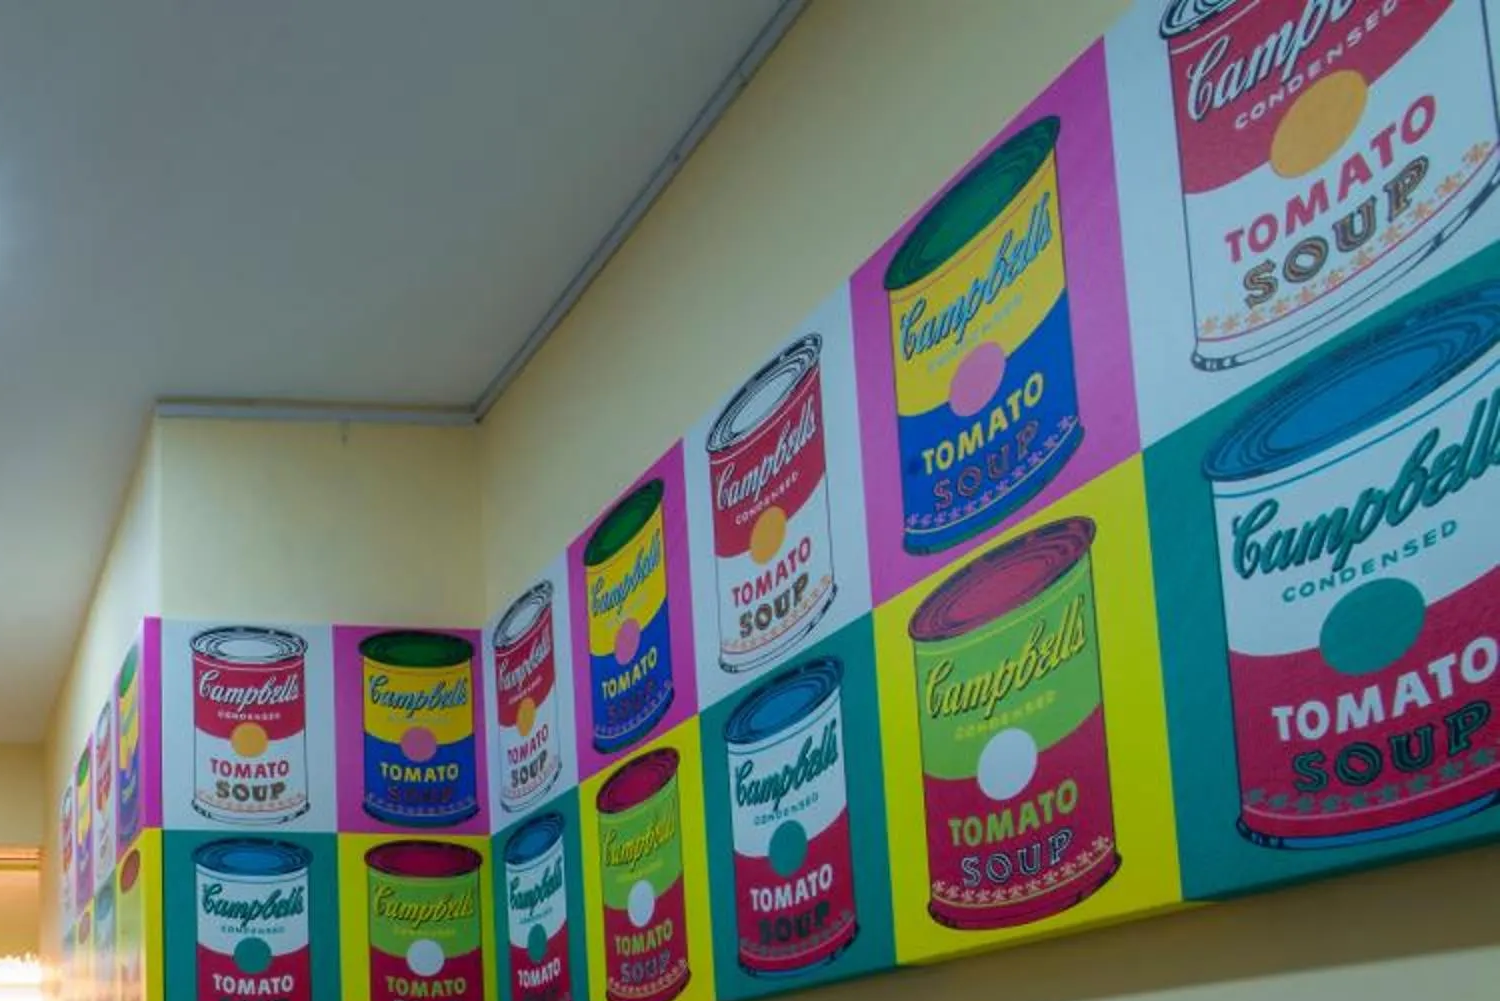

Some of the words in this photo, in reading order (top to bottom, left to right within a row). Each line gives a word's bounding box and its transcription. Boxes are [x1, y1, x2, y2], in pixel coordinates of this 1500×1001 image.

[1235, 0, 1398, 129] CONDENSED
[1224, 94, 1437, 264] TOMATO
[1243, 155, 1430, 308] SOUP
[922, 372, 1044, 475] TOMATO
[932, 420, 1039, 510] SOUP
[731, 537, 811, 608] TOMATO
[1281, 519, 1459, 604] CONDENSED
[739, 572, 809, 638] SOUP
[602, 646, 657, 699] TOMATO
[1271, 637, 1500, 742] TOMATO
[209, 757, 289, 778] TOMATO
[507, 724, 549, 764] TOMATO
[511, 749, 547, 787] SOUP
[1292, 699, 1492, 794] SOUP
[215, 780, 286, 802] SOUP
[380, 762, 459, 783] TOMATO
[948, 779, 1079, 848] TOMATO
[960, 829, 1074, 888] SOUP
[749, 863, 833, 913] TOMATO
[614, 919, 672, 957] TOMATO
[758, 900, 829, 945] SOUP
[212, 973, 294, 996] TOMATO
[385, 975, 466, 998] TOMATO
[517, 958, 561, 989] TOMATO
[620, 947, 670, 984] SOUP
